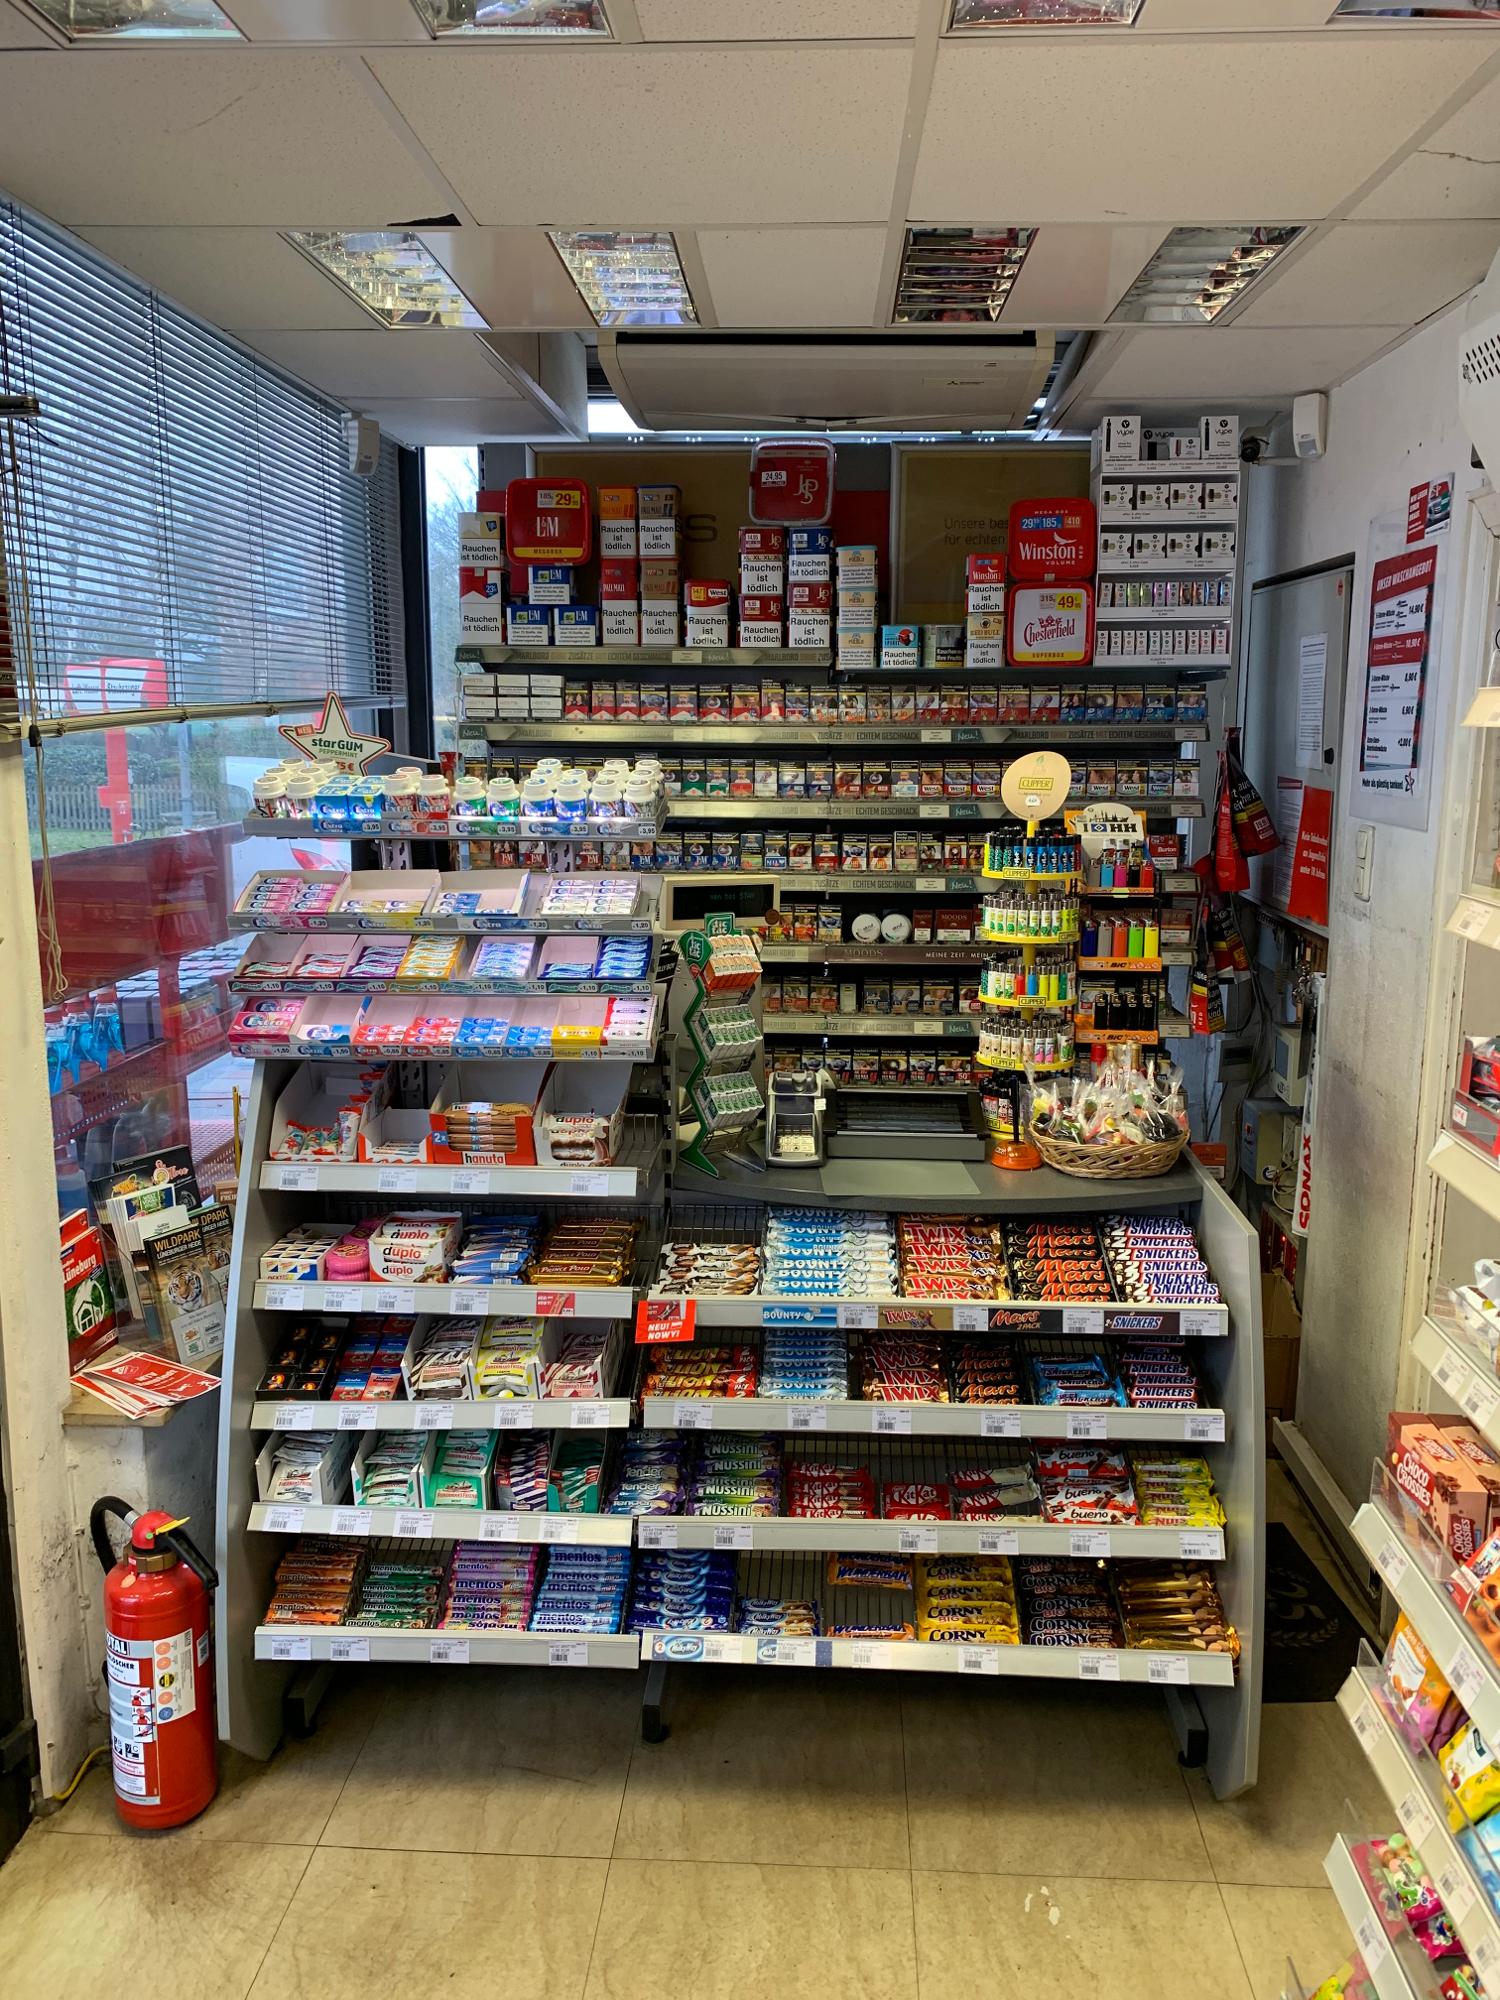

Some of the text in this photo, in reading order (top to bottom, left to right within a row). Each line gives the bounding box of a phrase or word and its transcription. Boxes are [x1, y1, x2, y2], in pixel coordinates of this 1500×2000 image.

[1116, 429, 1134, 437] vype
[1155, 431, 1175, 439] vype
[536, 516, 559, 538] L&M
[641, 525, 675, 533] Rauchen
[944, 519, 985, 530] Unsere
[601, 526, 635, 534] Rauchen
[613, 534, 623, 542] ist
[653, 534, 663, 542] ist
[462, 544, 497, 553] Rauchen
[605, 543, 632, 551] tödlich
[644, 543, 671, 551] tödlich
[1019, 542, 1076, 561] Winston
[471, 553, 499, 562] tödlich
[743, 564, 782, 573] Rauchen
[791, 560, 827, 568] Rauchen
[801, 568, 829, 577] tödlich
[972, 571, 998, 580] Winston
[748, 583, 778, 592] tödlich
[968, 584, 1004, 593] Rauchen
[711, 589, 727, 597] West
[973, 603, 1000, 611] tödlich
[1057, 596, 1074, 608] 49
[603, 609, 638, 618] Rauchen
[643, 609, 678, 617] Rauchen
[464, 615, 498, 624] Rauchen
[689, 617, 727, 625] Rauchen
[791, 618, 829, 626] Rauchen
[473, 624, 500, 633] tödlich
[607, 626, 634, 635] tödlich
[647, 626, 674, 636] tödlich
[744, 626, 775, 635] Rauchen
[1023, 618, 1075, 647] Chesterfield
[754, 634, 781, 643] tödlich
[795, 636, 825, 646] tödlich
[970, 642, 1000, 651] Rauchen
[885, 650, 916, 659] Rauchen
[893, 659, 917, 667] tödlich
[973, 658, 997, 666] tödlich
[857, 732, 879, 741] ECHTEM
[881, 732, 919, 741] GESCHMACK
[957, 729, 981, 741] Neu!
[319, 749, 358, 759] PEPPERMINT
[1021, 780, 1052, 788] CLIPPER
[1362, 778, 1371, 788] Mehr
[1377, 779, 1390, 791] günstig
[924, 786, 941, 794] West
[952, 785, 967, 794] West
[980, 785, 994, 794] West
[1093, 785, 1109, 794] West
[1124, 785, 1140, 794] West
[856, 805, 879, 816] ECHTEM
[880, 805, 919, 816] GESCHMACK
[954, 802, 978, 815] Neu!
[1110, 823, 1138, 833] HH
[1158, 847, 1177, 855] Burton
[1005, 869, 1028, 878] CLIPPER
[853, 880, 877, 889] ECHTEM
[878, 880, 915, 889] GESCHMACK
[248, 1014, 283, 1028] Extra
[464, 1152, 504, 1165] hanuta
[1299, 1134, 1312, 1229] SONAX
[904, 1222, 966, 1243] TWIX
[1130, 1226, 1192, 1236] SNICKERS
[154, 1229, 202, 1253] WILDPARK
[1026, 1234, 1096, 1248] Mars
[156, 1239, 202, 1260] LÜNEBURGER HEIDE
[382, 1243, 421, 1259] duplo
[907, 1243, 970, 1259] TWIX
[1136, 1249, 1199, 1259] SNICKERS
[541, 1264, 591, 1274] PRINCE POLO
[783, 1258, 850, 1270] BOUNTY
[908, 1257, 971, 1272] TWIX
[1035, 1259, 1103, 1272] Mars
[1144, 1261, 1206, 1272] SNICKERS
[382, 1265, 413, 1276] duplo
[1036, 1270, 1105, 1284] Mars
[1144, 1273, 1207, 1285] SNICKERS
[779, 1279, 847, 1290] BOUNTY
[906, 1276, 969, 1291] TWIX
[1040, 1282, 1111, 1296] Mars
[1153, 1283, 1217, 1295] SNICKERS
[763, 1311, 801, 1319] BOUNTY
[884, 1309, 917, 1323] TWIX
[990, 1309, 1041, 1328] Mars
[648, 1322, 670, 1331] NEU!
[1114, 1317, 1160, 1329] SNICKERS
[648, 1330, 680, 1340] NOWY!
[676, 1347, 719, 1359] LION
[1132, 1363, 1189, 1374] SNICKERS
[663, 1375, 713, 1387] LION
[878, 1385, 940, 1402] TWIX
[961, 1383, 1019, 1398] Mars
[1134, 1387, 1193, 1397] SNICKERS
[1058, 1449, 1095, 1460] bueno
[626, 1466, 663, 1478] Tender
[1403, 1452, 1430, 1488] CHOCO
[1396, 1462, 1432, 1507] CROSSIES
[898, 1485, 938, 1505] KitKat
[1064, 1487, 1103, 1500] bueno
[1070, 1507, 1109, 1520] bueno
[1452, 1522, 1466, 1554] CHOCO
[555, 1552, 600, 1562] mentos
[552, 1572, 598, 1581] mentos
[926, 1566, 980, 1579] CORNY
[455, 1580, 503, 1589] mentos
[548, 1583, 596, 1592] mentos
[926, 1586, 981, 1599] CORNY
[452, 1595, 501, 1604] mentos
[542, 1600, 590, 1609] mentos
[452, 1611, 500, 1620] mentos
[927, 1606, 982, 1619] CORNY
[928, 1629, 986, 1642] CORNY
[1029, 1633, 1088, 1646] CORNY
